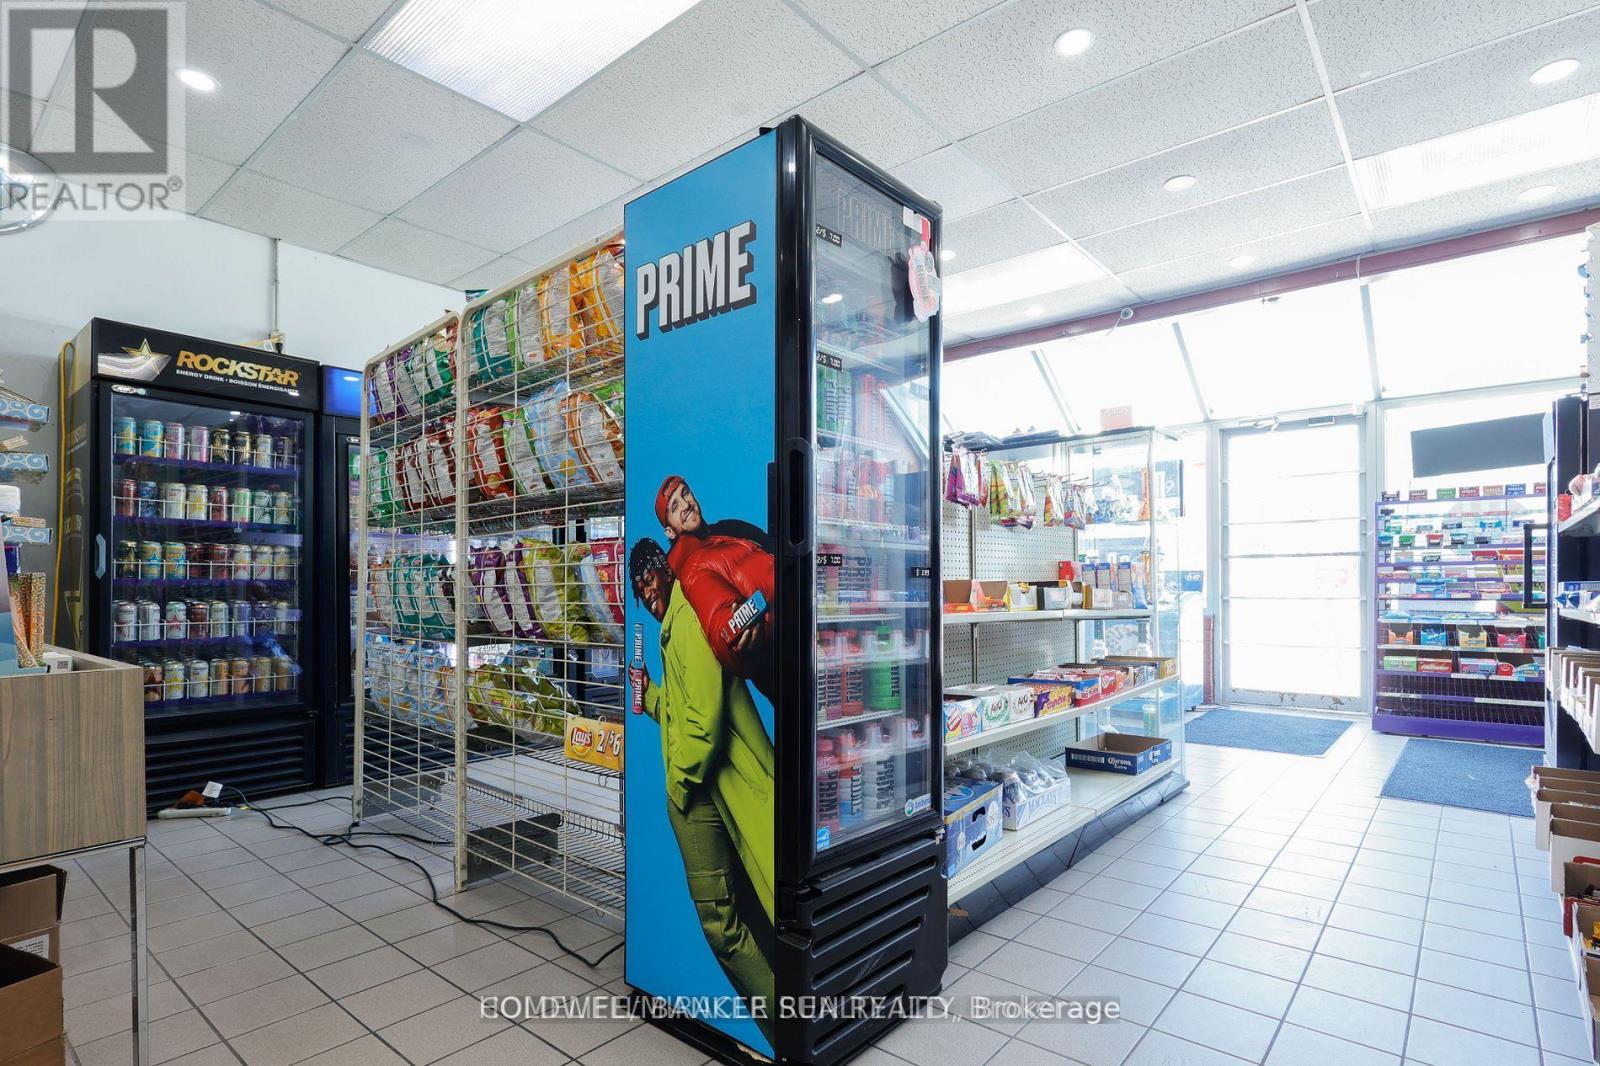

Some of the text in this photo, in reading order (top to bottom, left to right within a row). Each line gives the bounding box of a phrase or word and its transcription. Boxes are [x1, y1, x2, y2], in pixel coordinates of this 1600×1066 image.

[636, 219, 757, 341] PRIME
[176, 350, 300, 387] ROCKSTAR
[176, 369, 203, 378] ENERGY
[204, 374, 224, 382] DRINK
[728, 599, 759, 634] PRIME
[634, 632, 643, 661] PRIME
[633, 679, 642, 706] PRIME
[571, 727, 593, 746] Lay's
